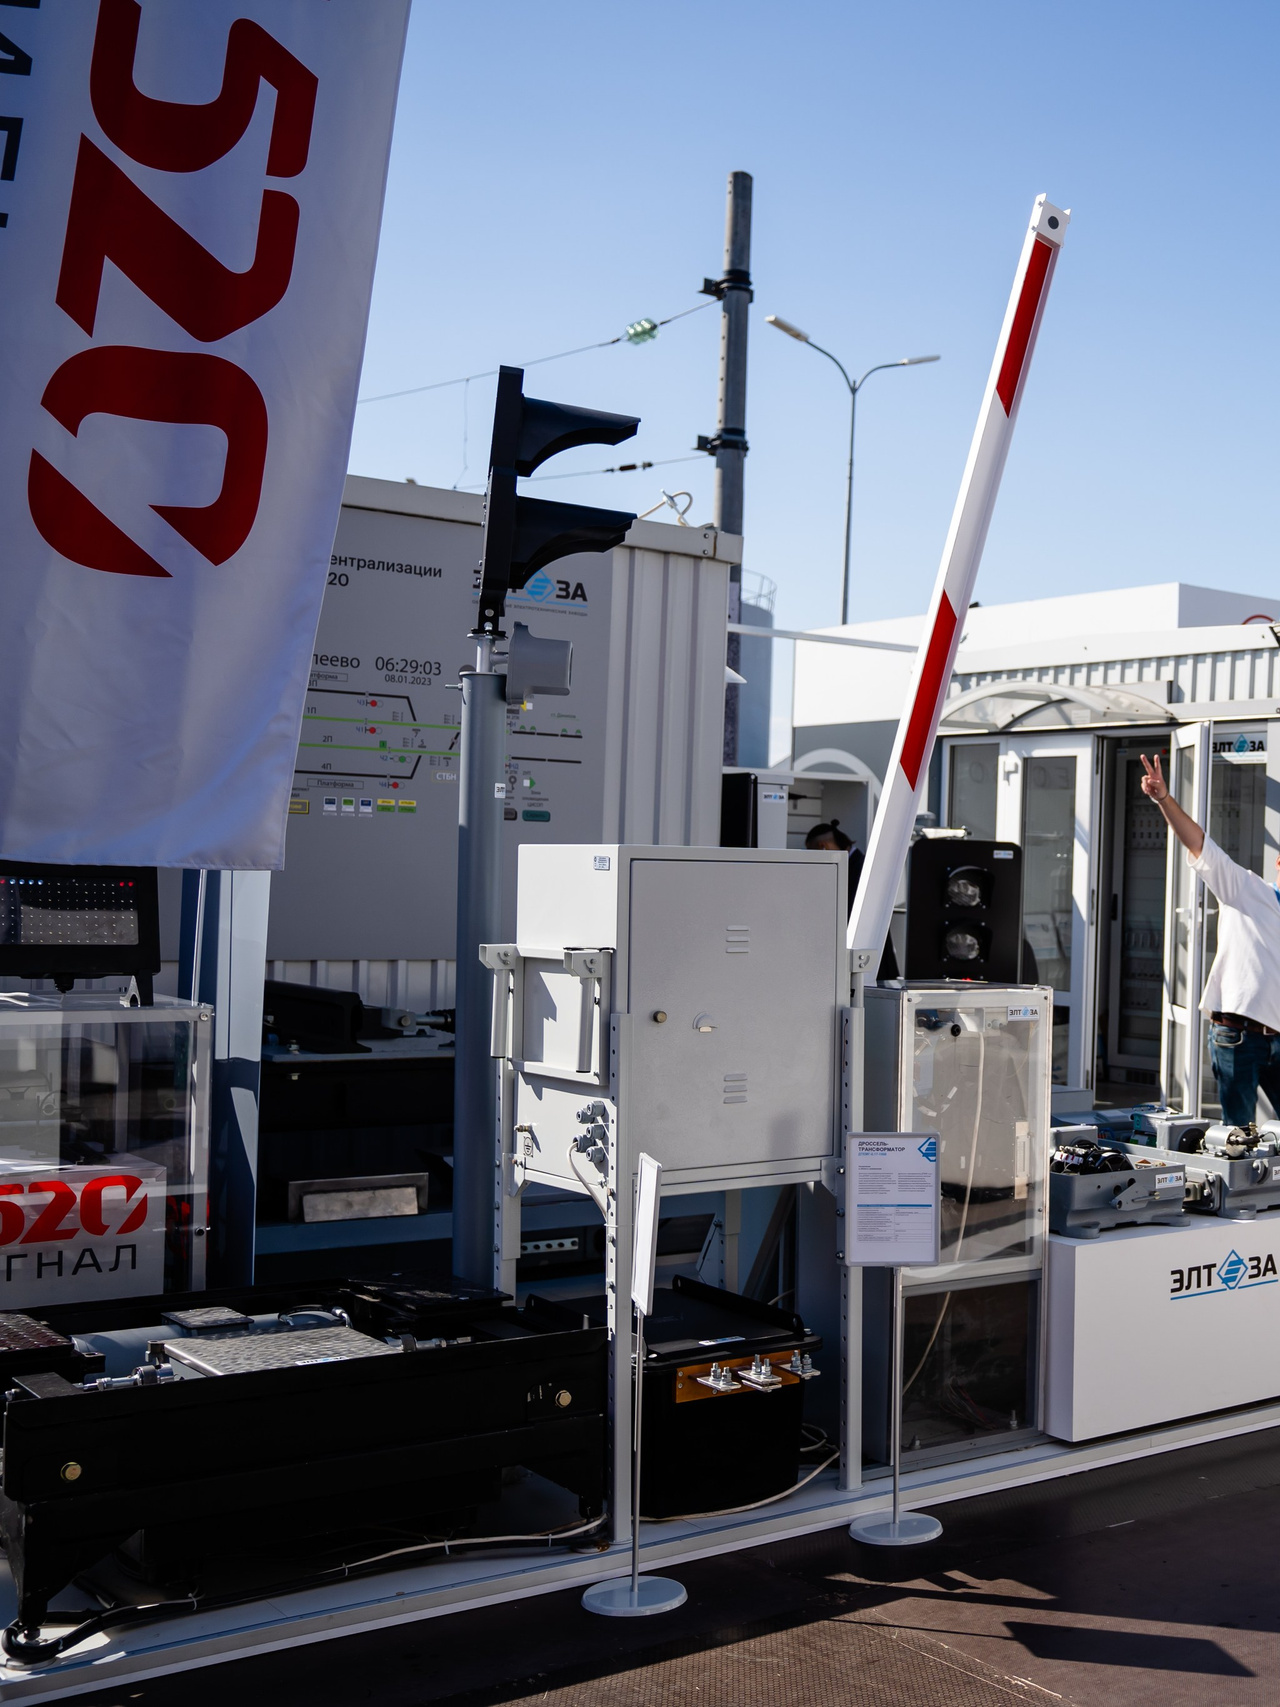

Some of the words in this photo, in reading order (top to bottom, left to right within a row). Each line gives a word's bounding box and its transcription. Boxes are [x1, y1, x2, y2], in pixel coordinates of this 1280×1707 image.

[375, 656, 442, 676] 06:29:03
[384, 674, 432, 686] 08.01.2023
[6, 1244, 137, 1281] ГНАЛ
